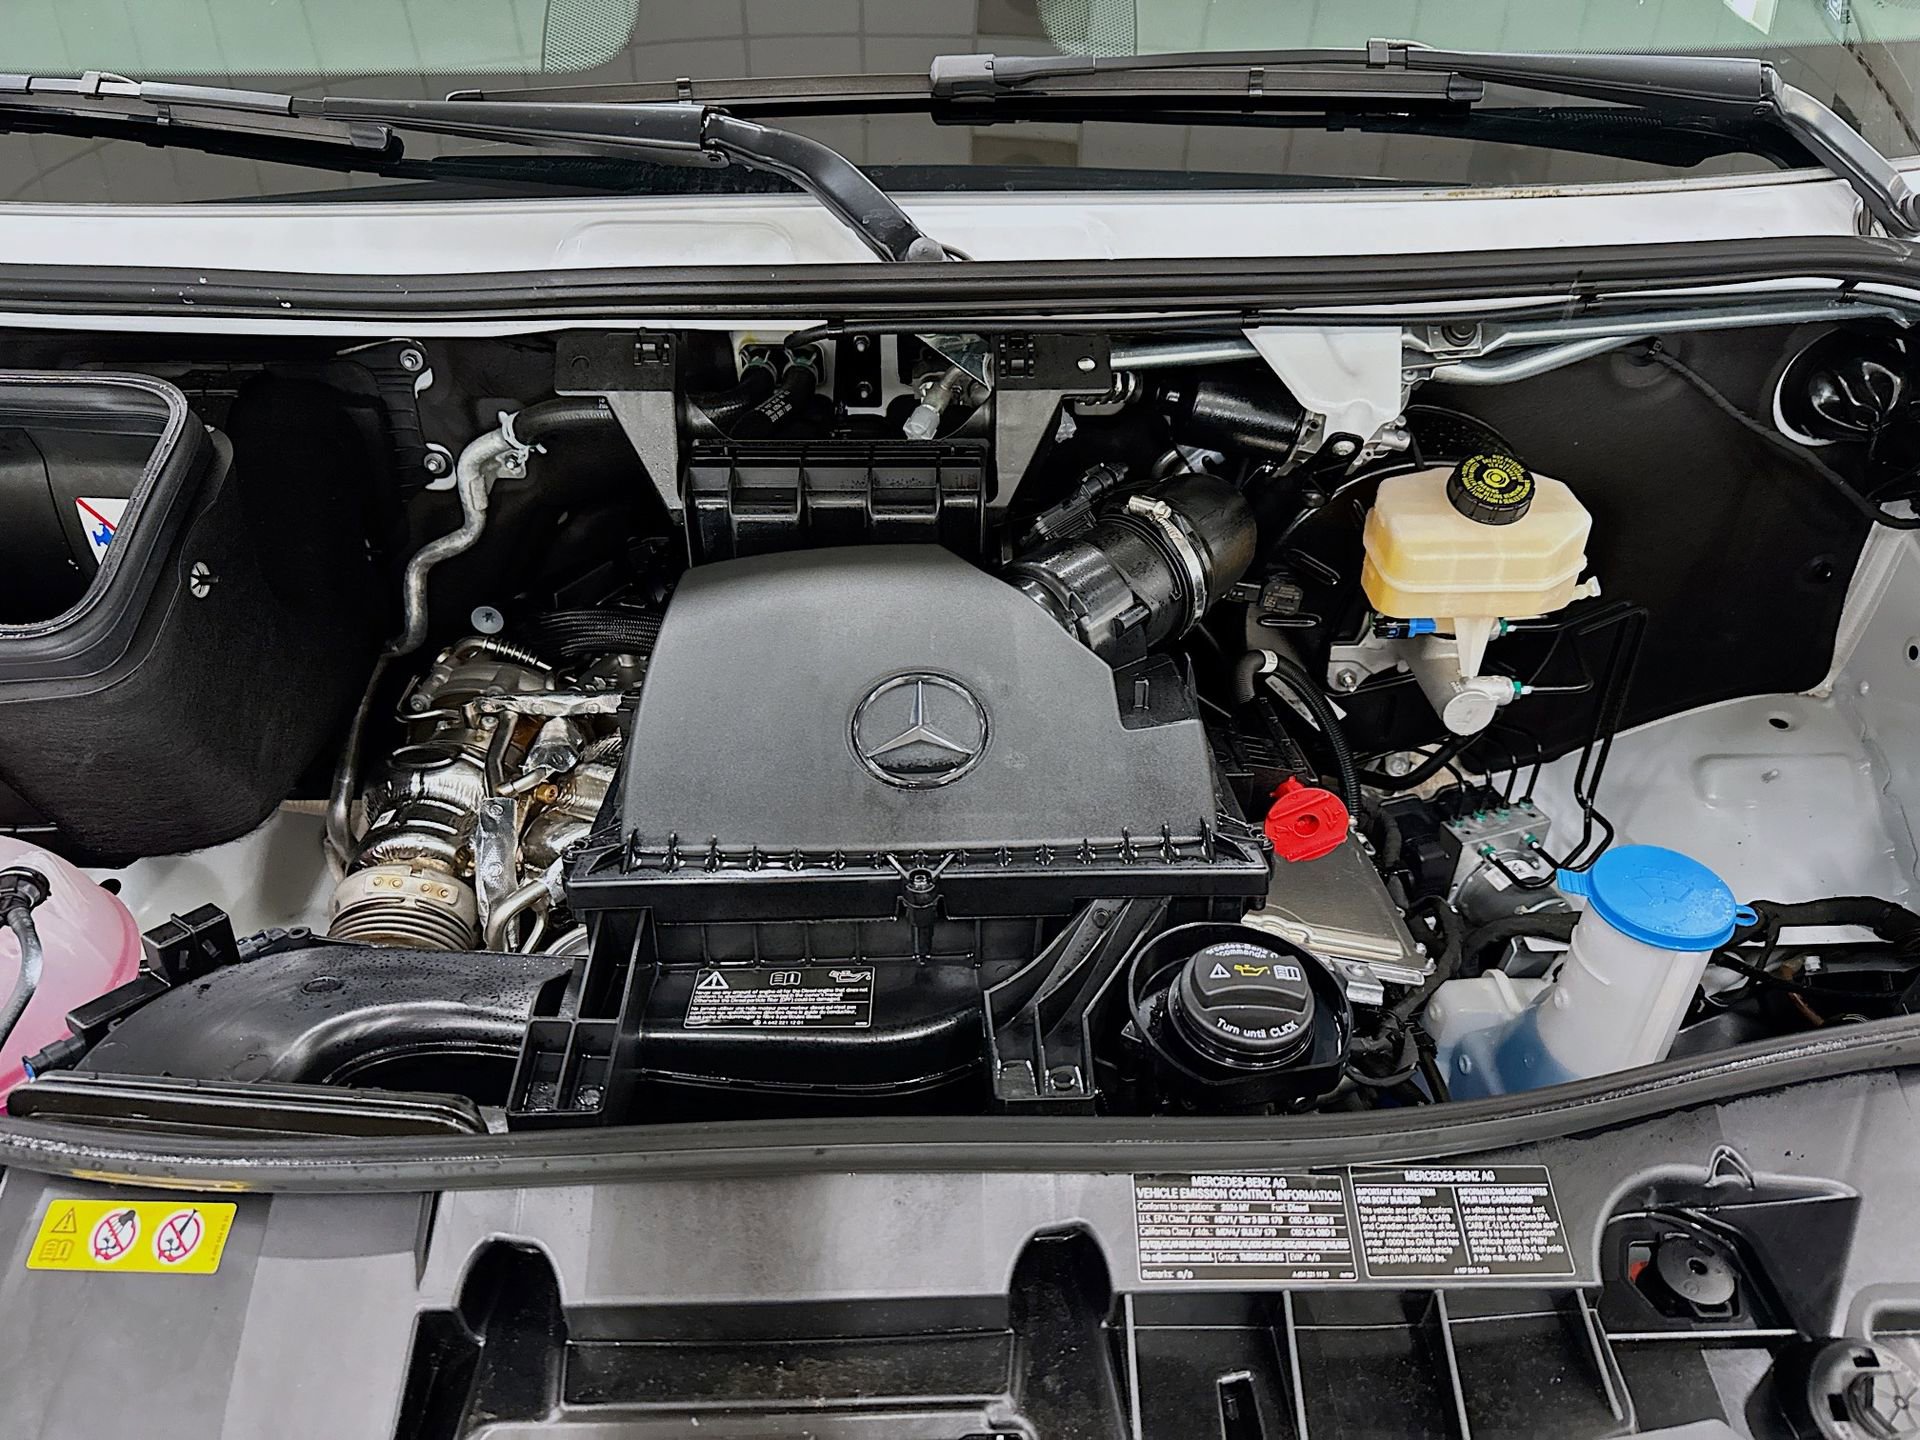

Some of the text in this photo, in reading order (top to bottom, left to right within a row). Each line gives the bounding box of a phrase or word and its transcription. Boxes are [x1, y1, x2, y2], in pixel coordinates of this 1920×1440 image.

[1217, 1017, 1299, 1039] Turn until CLICK
[1404, 1170, 1496, 1182] MERCEDES-BENZ AG
[1190, 1176, 1287, 1188] MERCEDES-BENZ AG
[1136, 1188, 1342, 1201] VEHICLE EMISSION CONTROL INFORMATION
[1356, 1188, 1436, 1196] IMPORTANT INFORMATION
[1505, 1188, 1548, 1196] IMPORTANTES
[1357, 1196, 1421, 1204] FOR BODY BUILDERS
[1460, 1196, 1534, 1204] POUR LES CARROSSIERS
[1137, 1202, 1170, 1211] Conforms
[1170, 1203, 1178, 1211] to
[1178, 1203, 1216, 1212] regulations:
[1271, 1202, 1287, 1212] Fuel:
[1288, 1202, 1310, 1212] Diesel
[1359, 1206, 1453, 1215] This vehicle and engine conform
[1462, 1206, 1470, 1214] Le
[1471, 1206, 1495, 1214] véhicule
[1496, 1206, 1503, 1214] et
[1138, 1214, 1151, 1224] U.S.
[1153, 1214, 1168, 1224] EPA
[1168, 1214, 1190, 1225] Class/
[1238, 1216, 1252, 1225] Tier
[1270, 1216, 1284, 1225] 170
[1360, 1214, 1368, 1222] to
[1368, 1214, 1376, 1222] all
[1377, 1214, 1408, 1222] applicable
[1408, 1214, 1418, 1222] US
[1433, 1214, 1451, 1222] CARB
[1464, 1213, 1550, 1222] conformes aux directives EPA
[1362, 1222, 1456, 1231] and Canadian regulations at the
[1139, 1227, 1171, 1236] California
[1172, 1227, 1194, 1237] Class/
[1218, 1252, 1239, 1262] Group:
[1306, 1252, 1321, 1263] n/a
[1142, 1269, 1194, 1280] Remarks: n/a
